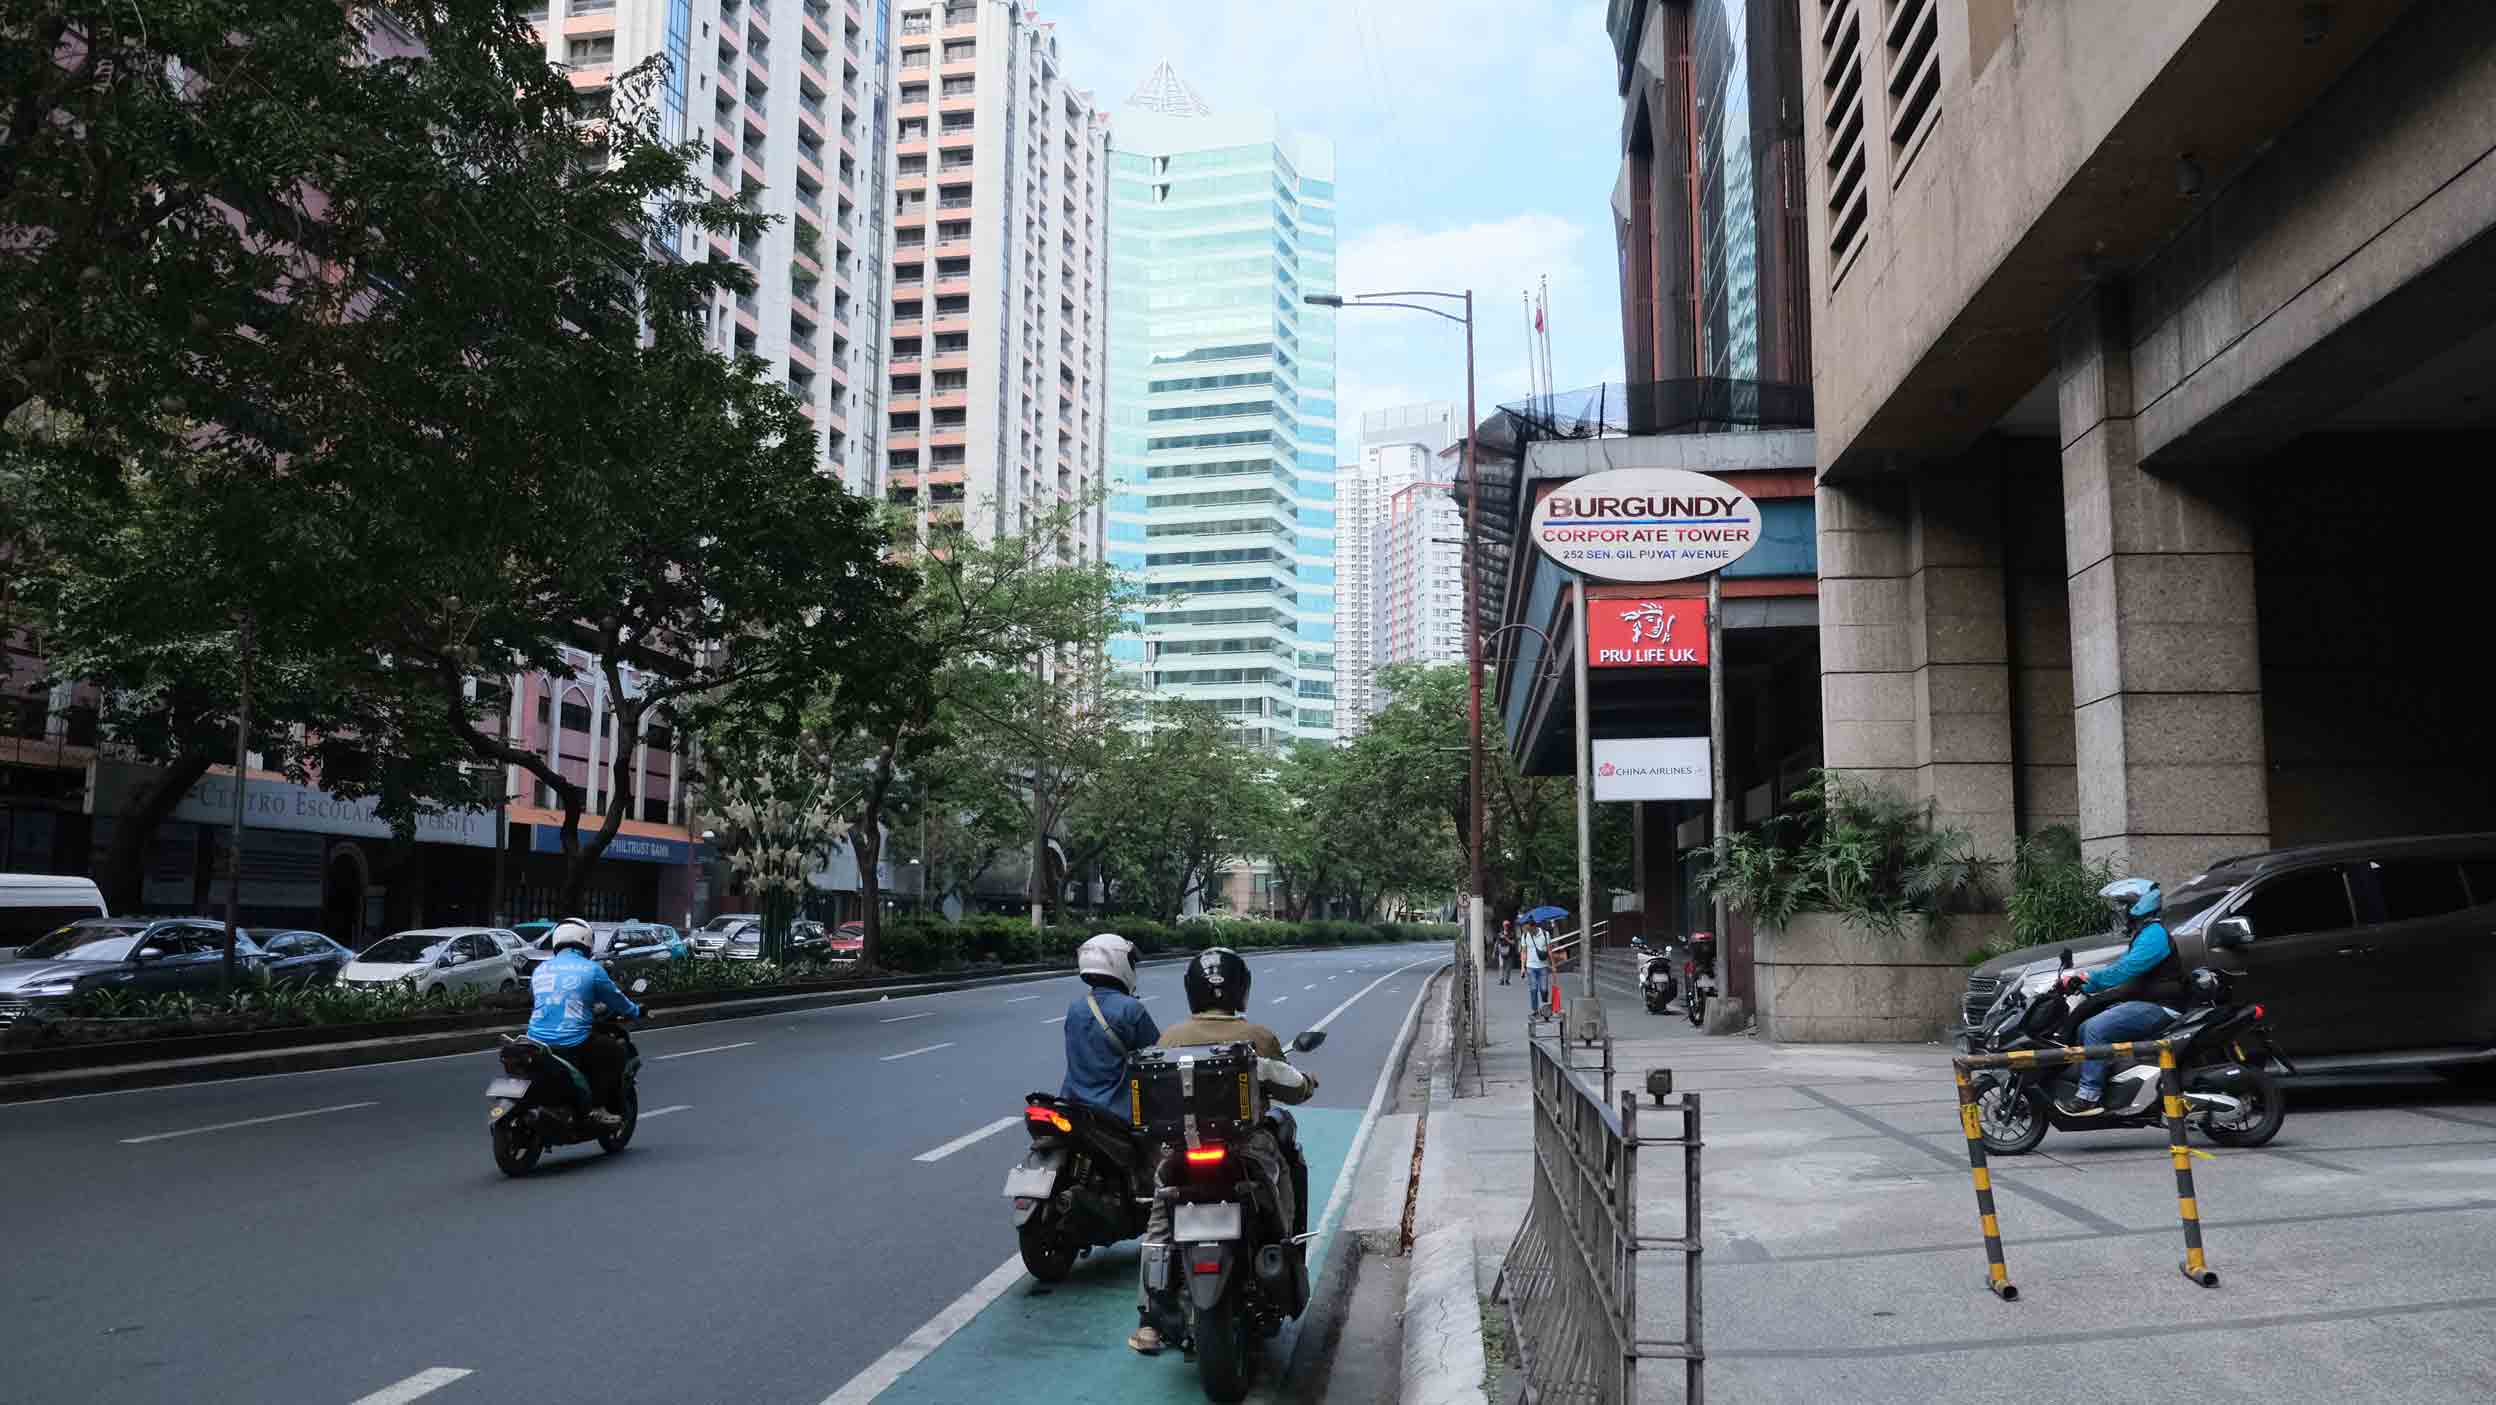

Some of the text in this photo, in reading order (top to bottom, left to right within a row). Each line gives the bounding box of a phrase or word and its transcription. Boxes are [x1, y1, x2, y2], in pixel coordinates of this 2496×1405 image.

[1548, 496, 1743, 518] BURGUNDY
[1543, 528, 1750, 543] CORPORATE TOWER
[1563, 550, 1729, 560] 252 SEN. GIL PUYAT AVENUE
[1600, 649, 1632, 663] PRU
[1636, 649, 1665, 662] LIFE
[1615, 767, 1694, 776] CHINA AIRLINES
